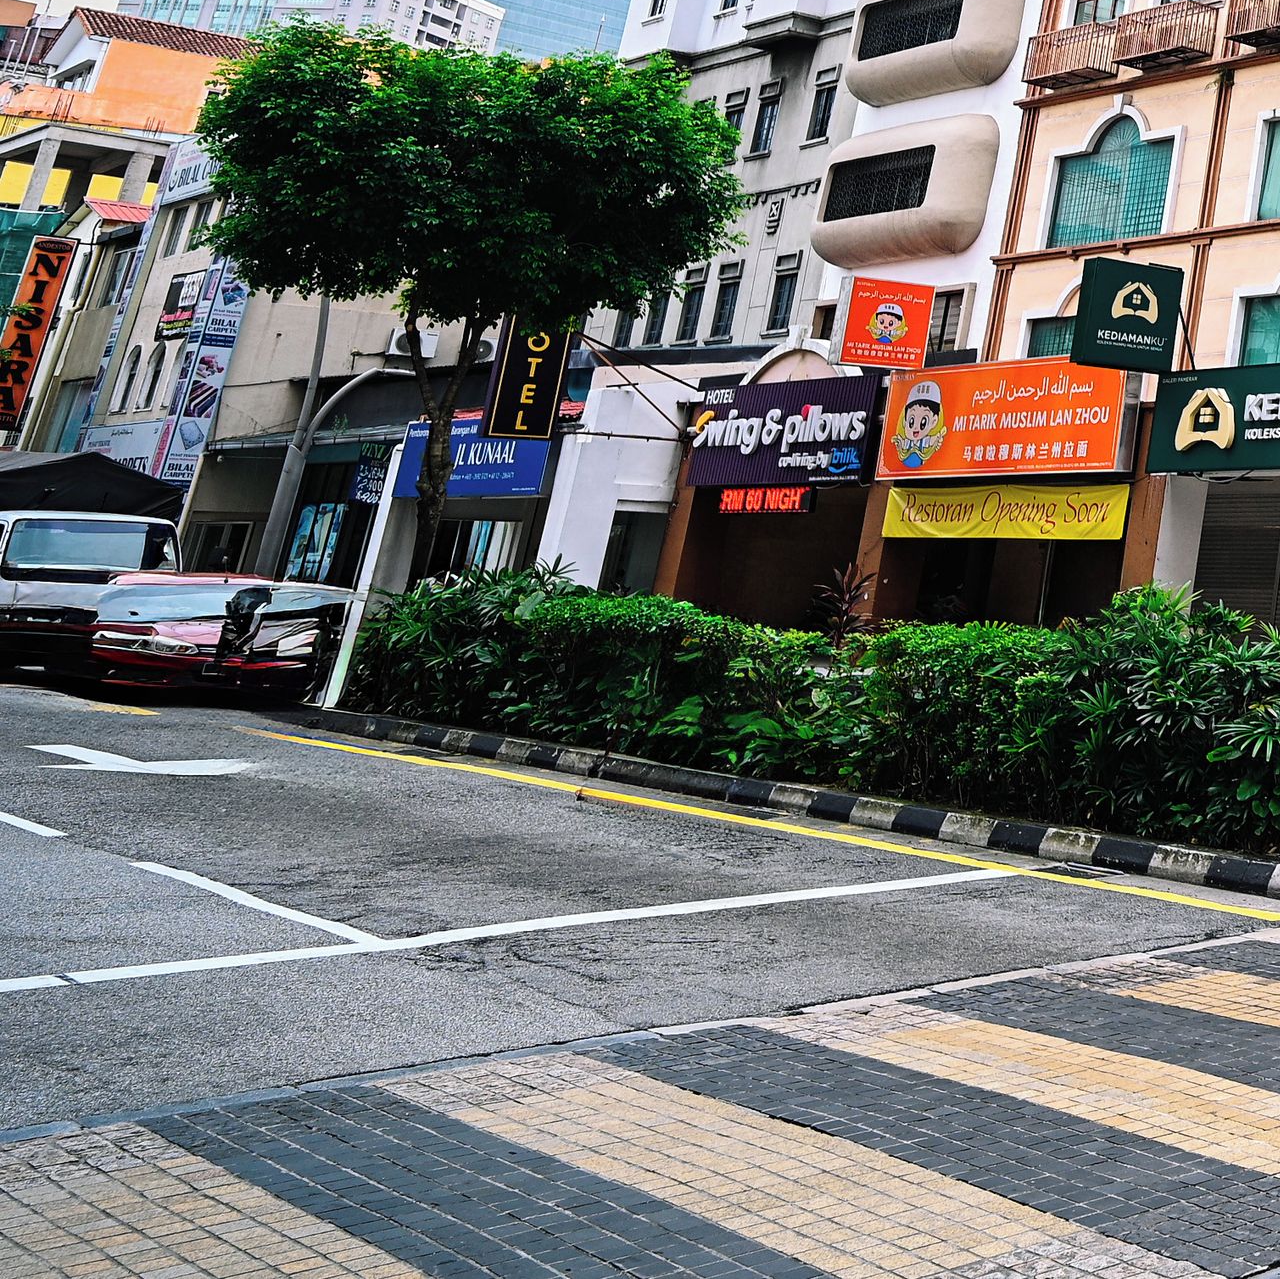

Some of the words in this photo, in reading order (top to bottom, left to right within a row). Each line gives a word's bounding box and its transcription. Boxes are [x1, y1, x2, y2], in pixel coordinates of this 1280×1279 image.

[207, 326, 238, 335] CARPETS
[210, 317, 238, 328] BILAL
[871, 343, 893, 351] MUSLIM
[906, 346, 922, 354] ZHOU
[1096, 328, 1166, 347] KEDIAMANKU
[515, 332, 550, 431] OTEL
[1006, 376, 1050, 401] الرحمن
[1050, 371, 1070, 394] الله
[1069, 380, 1094, 401] بسم
[706, 388, 735, 405] HOTEL
[972, 379, 1007, 408] الرحيم
[761, 408, 783, 446] &
[780, 404, 867, 453] pillows
[952, 415, 967, 432] MI
[969, 412, 998, 431] TARIK
[999, 409, 1047, 430] MUSLIM
[1049, 407, 1073, 427] LAN
[1074, 405, 1110, 425] ZHOU
[467, 441, 516, 466] KUNAAL
[167, 462, 195, 472] BILAL
[721, 488, 745, 510] RM
[745, 487, 764, 510] 60
[764, 486, 811, 510] NIGH
[900, 492, 975, 524] Restoran
[980, 490, 1058, 535] Opening
[1063, 492, 1112, 524] Soon
